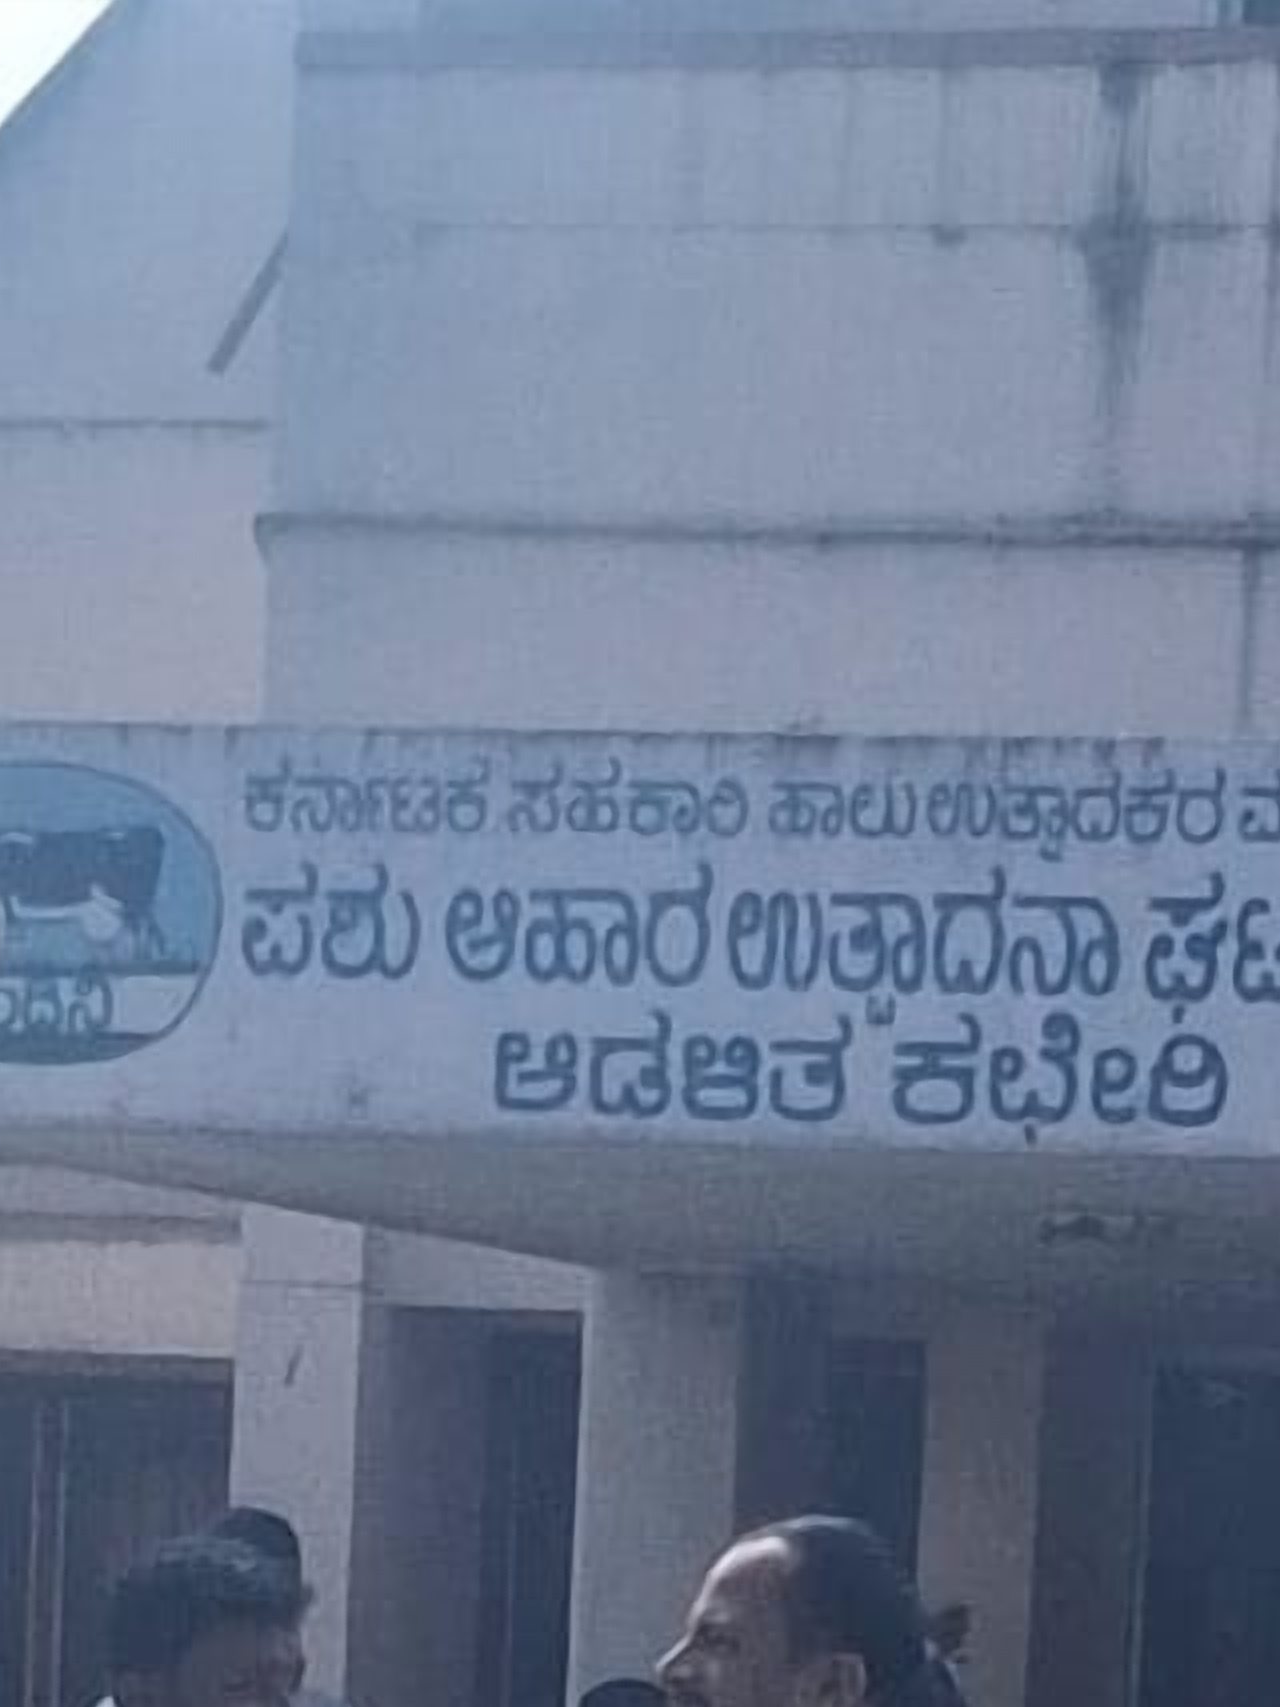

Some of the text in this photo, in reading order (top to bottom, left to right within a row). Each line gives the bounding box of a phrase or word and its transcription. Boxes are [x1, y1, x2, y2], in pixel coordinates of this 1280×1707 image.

[245, 756, 488, 833] ಕರ್ನಾಟಕ
[509, 757, 748, 836] ಸಹಕಾರಿ
[769, 780, 916, 838] ಹಾಲು
[926, 770, 1225, 862] ಉತ್ಪಾದಕರ
[241, 862, 418, 979] ಪಶು
[445, 861, 712, 987] ಆಹಾರ
[727, 867, 1121, 1025] ಉತ್ಪಾದನಾ
[494, 1003, 1228, 1144] ಆಡಳಿತ ಕಛೇರಿ
